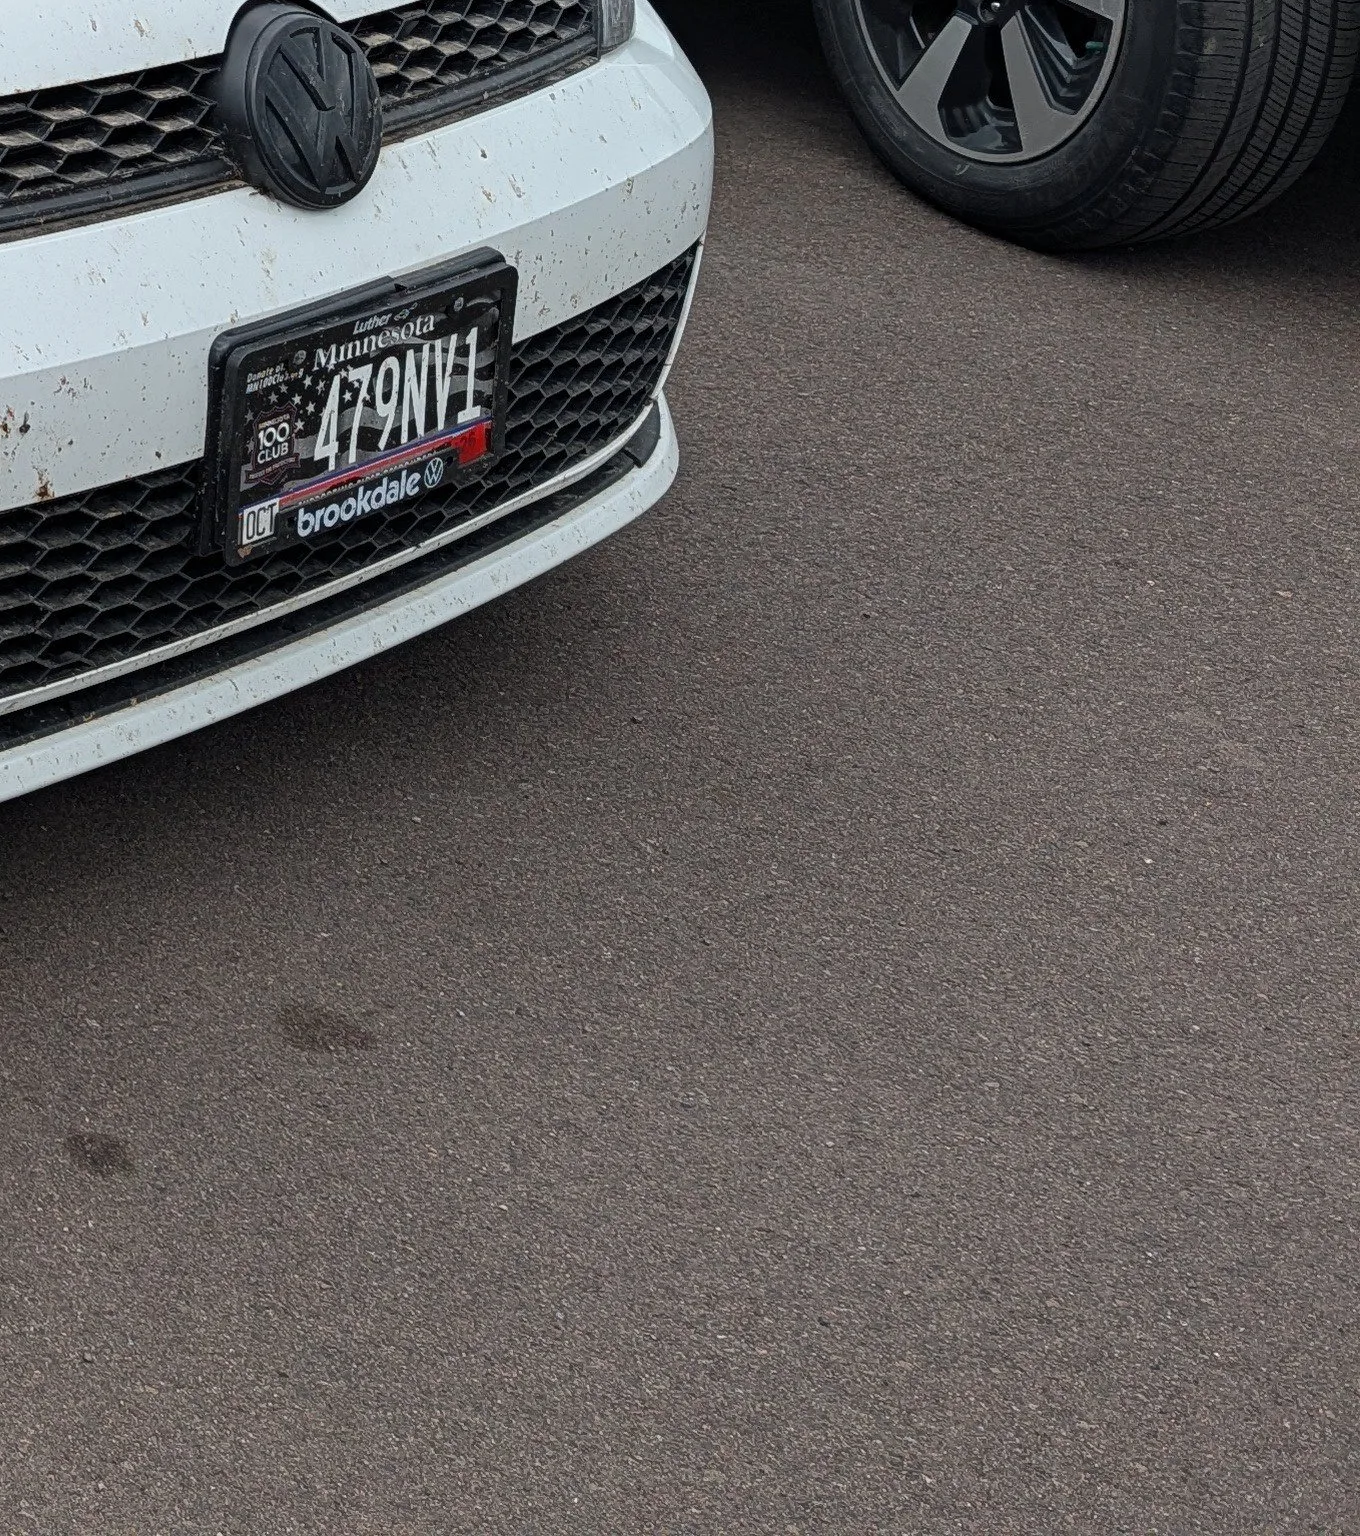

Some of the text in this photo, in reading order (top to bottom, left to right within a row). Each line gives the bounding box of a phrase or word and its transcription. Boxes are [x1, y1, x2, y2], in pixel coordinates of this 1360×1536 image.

[311, 314, 436, 372] Minnesota
[352, 313, 393, 335] Luther
[314, 326, 482, 472] 479NV1
[257, 442, 289, 465] CLUB
[258, 422, 290, 451] 100
[246, 502, 277, 540] OCT
[296, 469, 422, 538] brookdale
